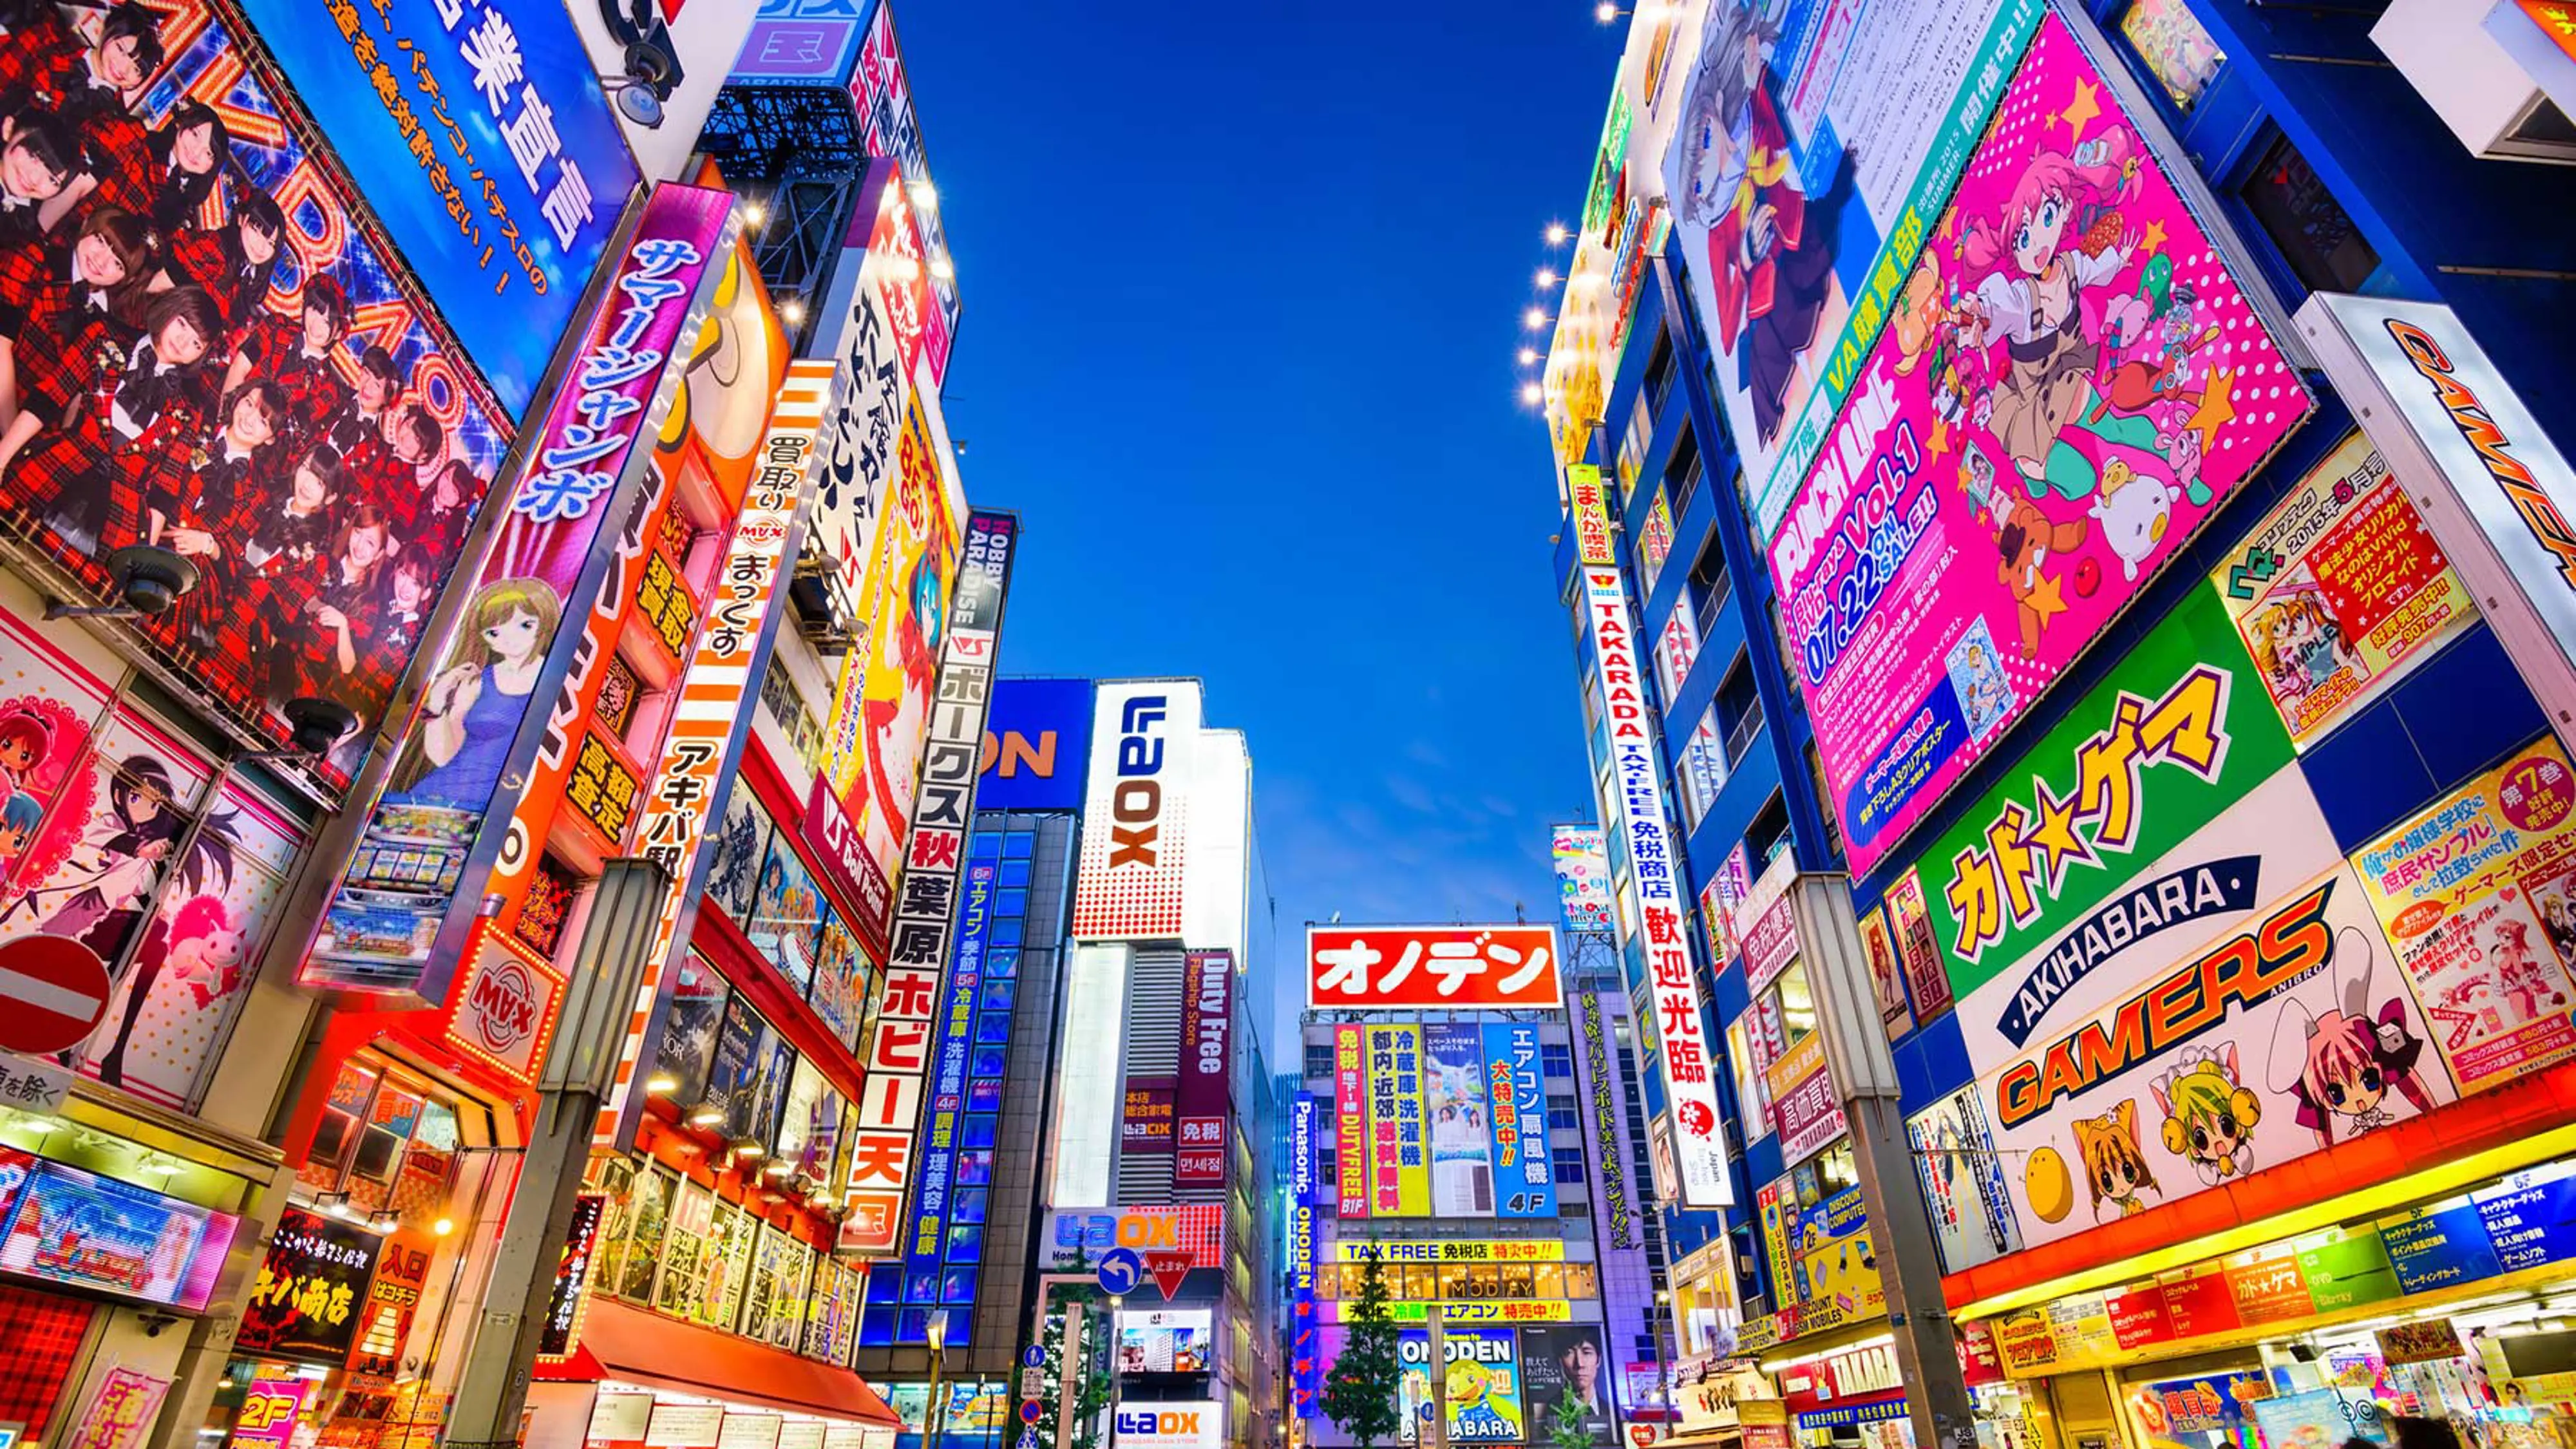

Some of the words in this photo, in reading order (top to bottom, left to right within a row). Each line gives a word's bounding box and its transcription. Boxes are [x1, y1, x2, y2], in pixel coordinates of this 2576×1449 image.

[513, 240, 701, 523] サマージャンボ
[1845, 422, 1920, 554] Vol.1
[986, 519, 1015, 589] HOBBY
[1874, 512, 1898, 558] ON
[954, 517, 992, 624] PARADISE
[709, 554, 779, 659] まっくす
[1806, 549, 1880, 685] 07.22
[1595, 604, 1644, 738] TAKARADA
[583, 733, 638, 806] 高額
[565, 765, 626, 846] 査定
[1631, 820, 1672, 899] 免税商店
[1199, 958, 1229, 1014] Duty
[1316, 931, 1549, 996] オノデン
[2269, 962, 2324, 999] ANIBRO
[1996, 876, 2338, 1130] GAMERS
[1198, 1018, 1227, 1074] Free
[936, 1097, 958, 1110] 4F
[1182, 1122, 1221, 1141] 免税
[1180, 1157, 1220, 1173] 면세점
[1294, 1101, 1312, 1195] Panasonic
[1507, 1194, 1544, 1213] 4F
[381, 1243, 433, 1282] 入口
[1155, 1260, 1186, 1273] 止まれ
[1297, 1207, 1311, 1289] ONODEN
[1390, 1245, 1439, 1259] FREE
[1444, 1244, 1488, 1259] 免税店
[1443, 1305, 1498, 1318] エアコン
[242, 1394, 294, 1428] 2F
[1402, 1420, 1517, 1438] AABARA
